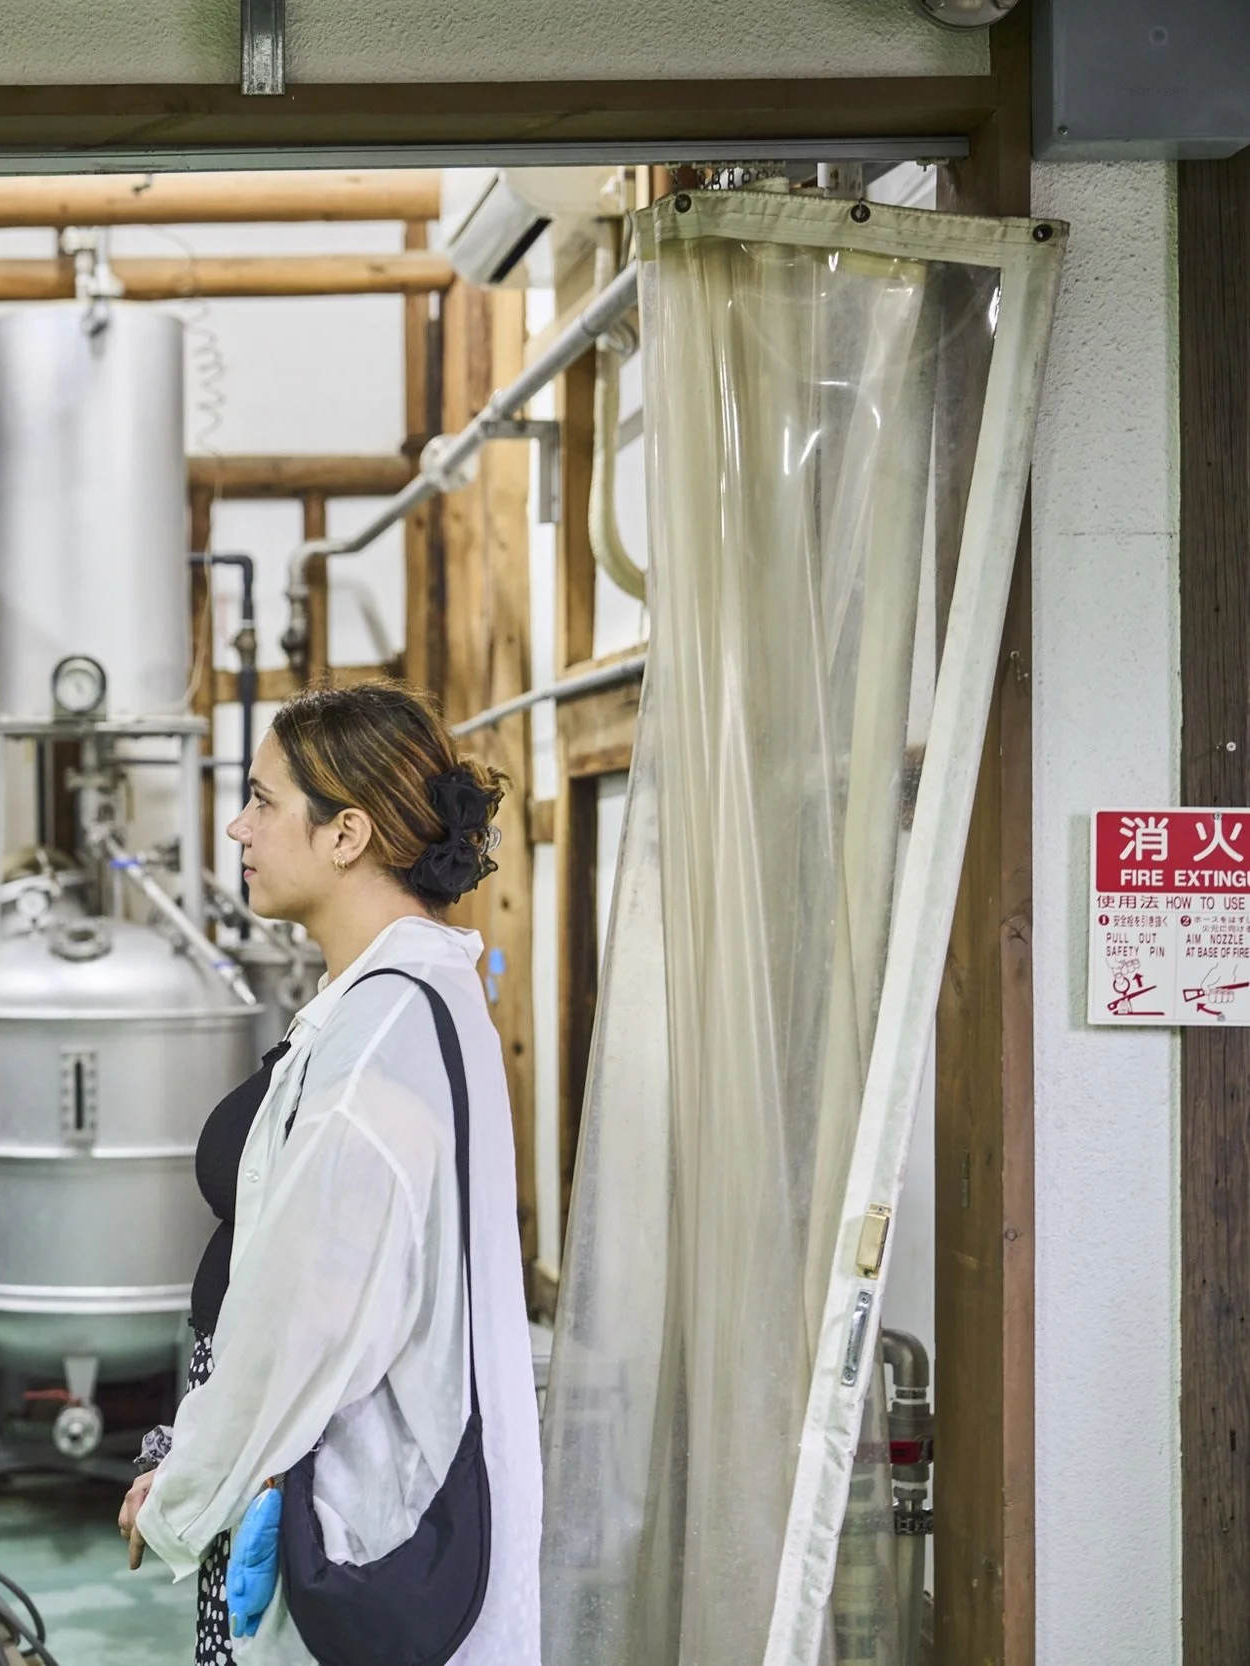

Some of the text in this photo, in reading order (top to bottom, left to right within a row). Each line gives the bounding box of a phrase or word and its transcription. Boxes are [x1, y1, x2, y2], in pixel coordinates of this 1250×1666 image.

[1120, 869, 1164, 887] FIRE
[1097, 895, 1159, 909] 使用法
[1166, 896, 1245, 910] HOW TO USE
[1106, 933, 1156, 944] PULL OUT
[1186, 934, 1244, 945] AIM NOZZLE
[1106, 946, 1165, 957] SAFETY PIN
[1186, 947, 1250, 958] AT BASE OF FIRE
